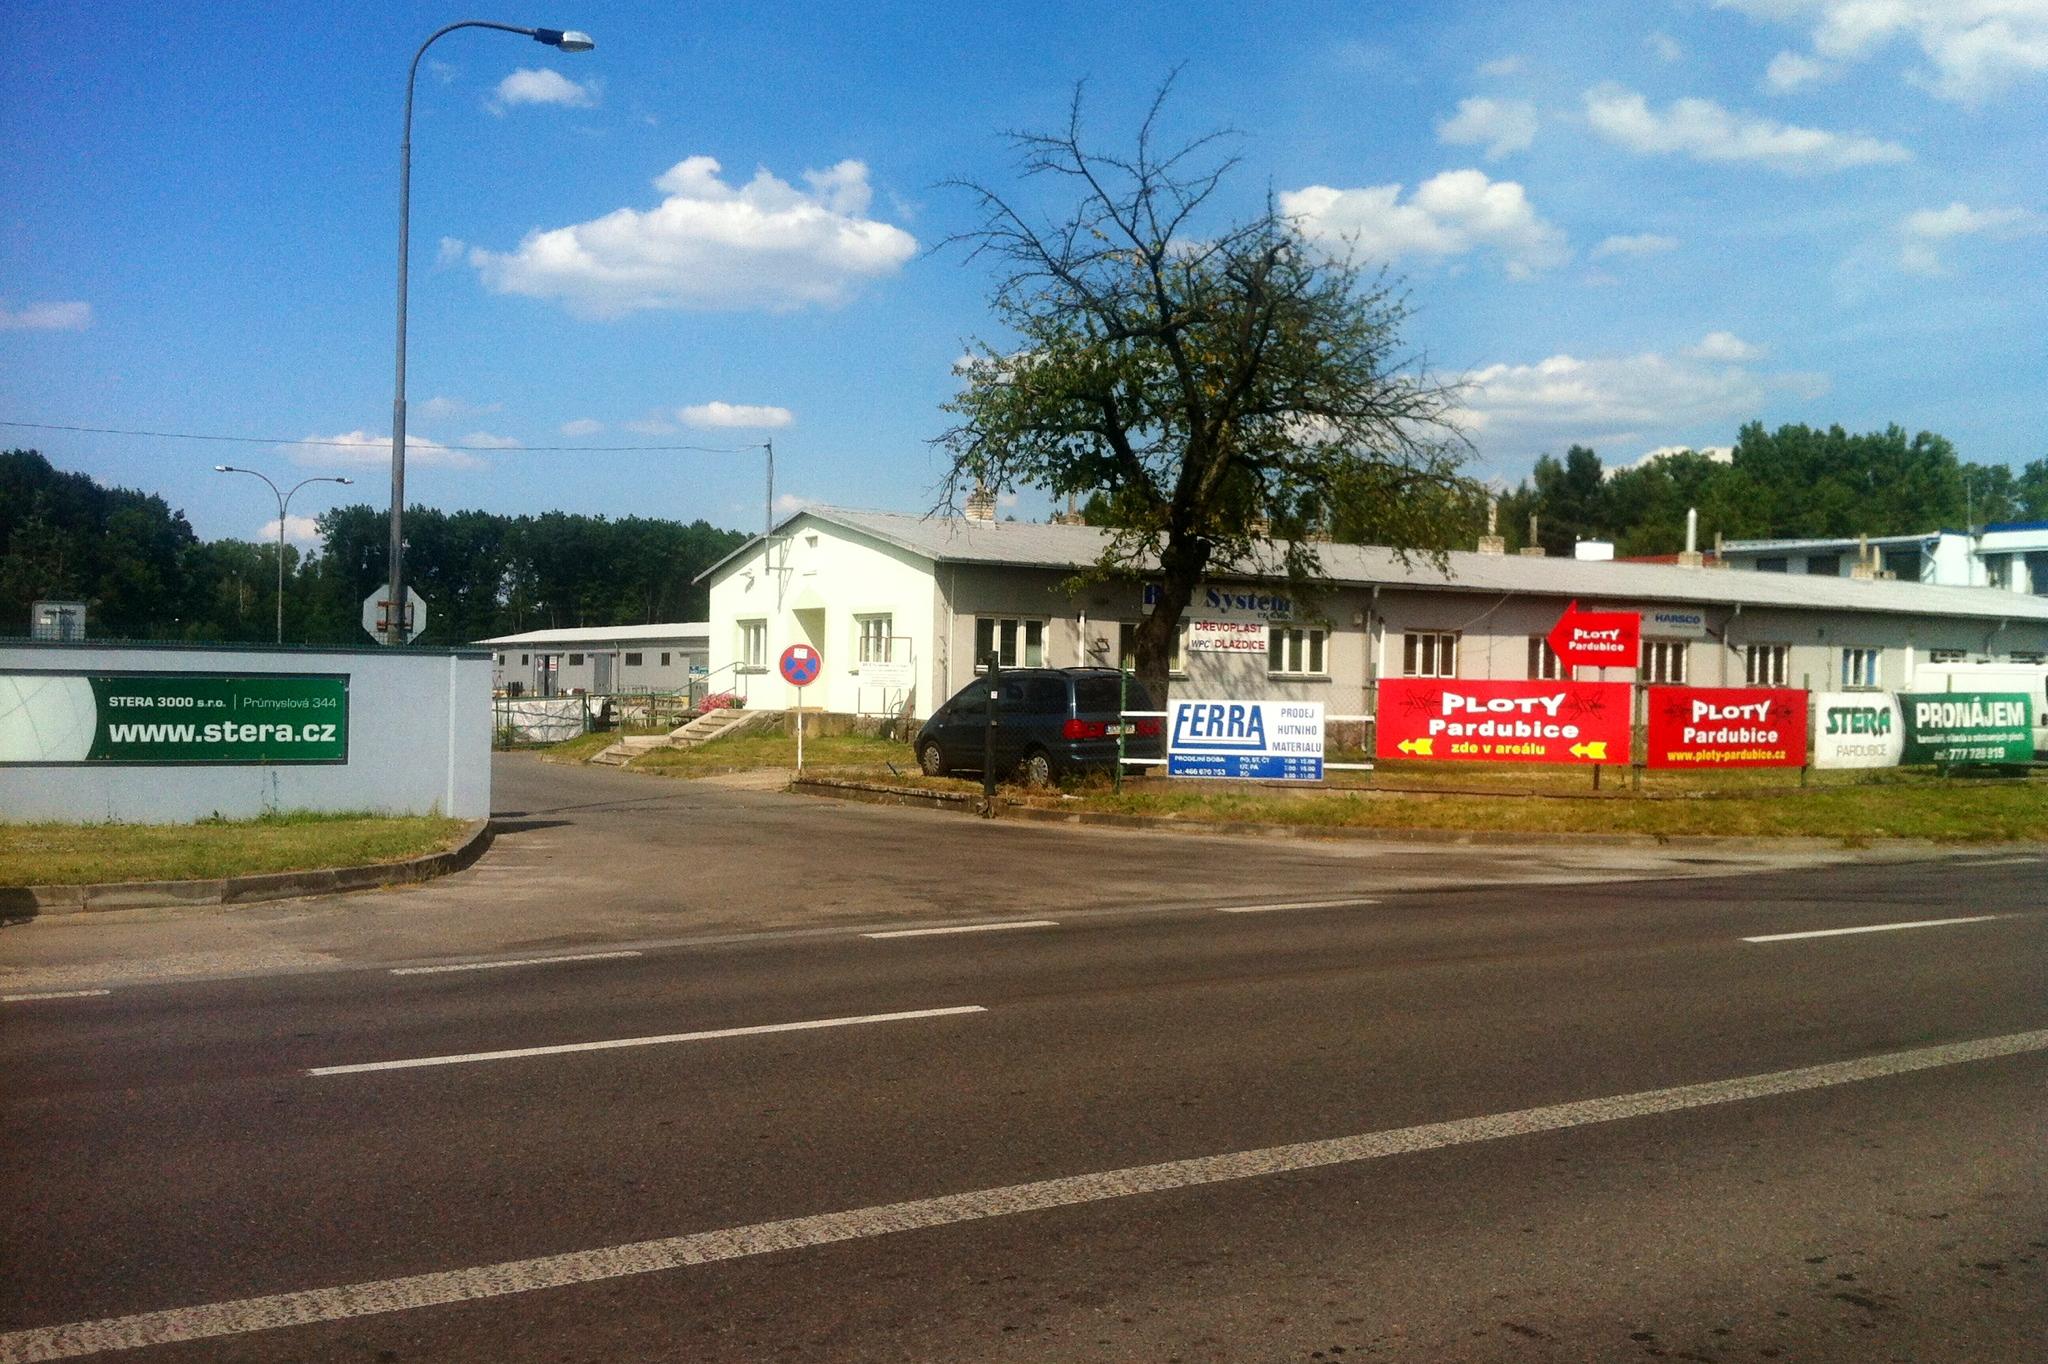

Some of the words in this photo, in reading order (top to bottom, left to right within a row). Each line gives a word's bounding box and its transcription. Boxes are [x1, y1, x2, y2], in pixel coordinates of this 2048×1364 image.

[1655, 614, 1700, 624] HARSCO
[1194, 620, 1263, 633] DŘEVOPLAST
[1574, 628, 1620, 640] PLOTY
[1191, 639, 1210, 648] WPC
[1568, 641, 1624, 652] Pardubice
[109, 697, 154, 707] STERA
[158, 697, 194, 707] 3000
[313, 698, 337, 708] 344
[1442, 691, 1566, 716] PLOTY
[1281, 708, 1315, 718] PRODEJ
[1692, 699, 1771, 723] PLOTY
[1916, 696, 2025, 728] PRONÁJEM
[1171, 704, 1267, 750] FERRA
[1428, 719, 1579, 738] Pardubice
[1826, 707, 1891, 737] STERA
[109, 721, 336, 742] www.stera.cz
[1683, 727, 1778, 743] Pardubice
[1451, 742, 1478, 753] zde
[1482, 744, 1492, 753] v
[1495, 742, 1546, 755] areálu
[1667, 748, 1786, 762] www.ploty-pardubice.cz
[1949, 749, 1967, 760] 777
